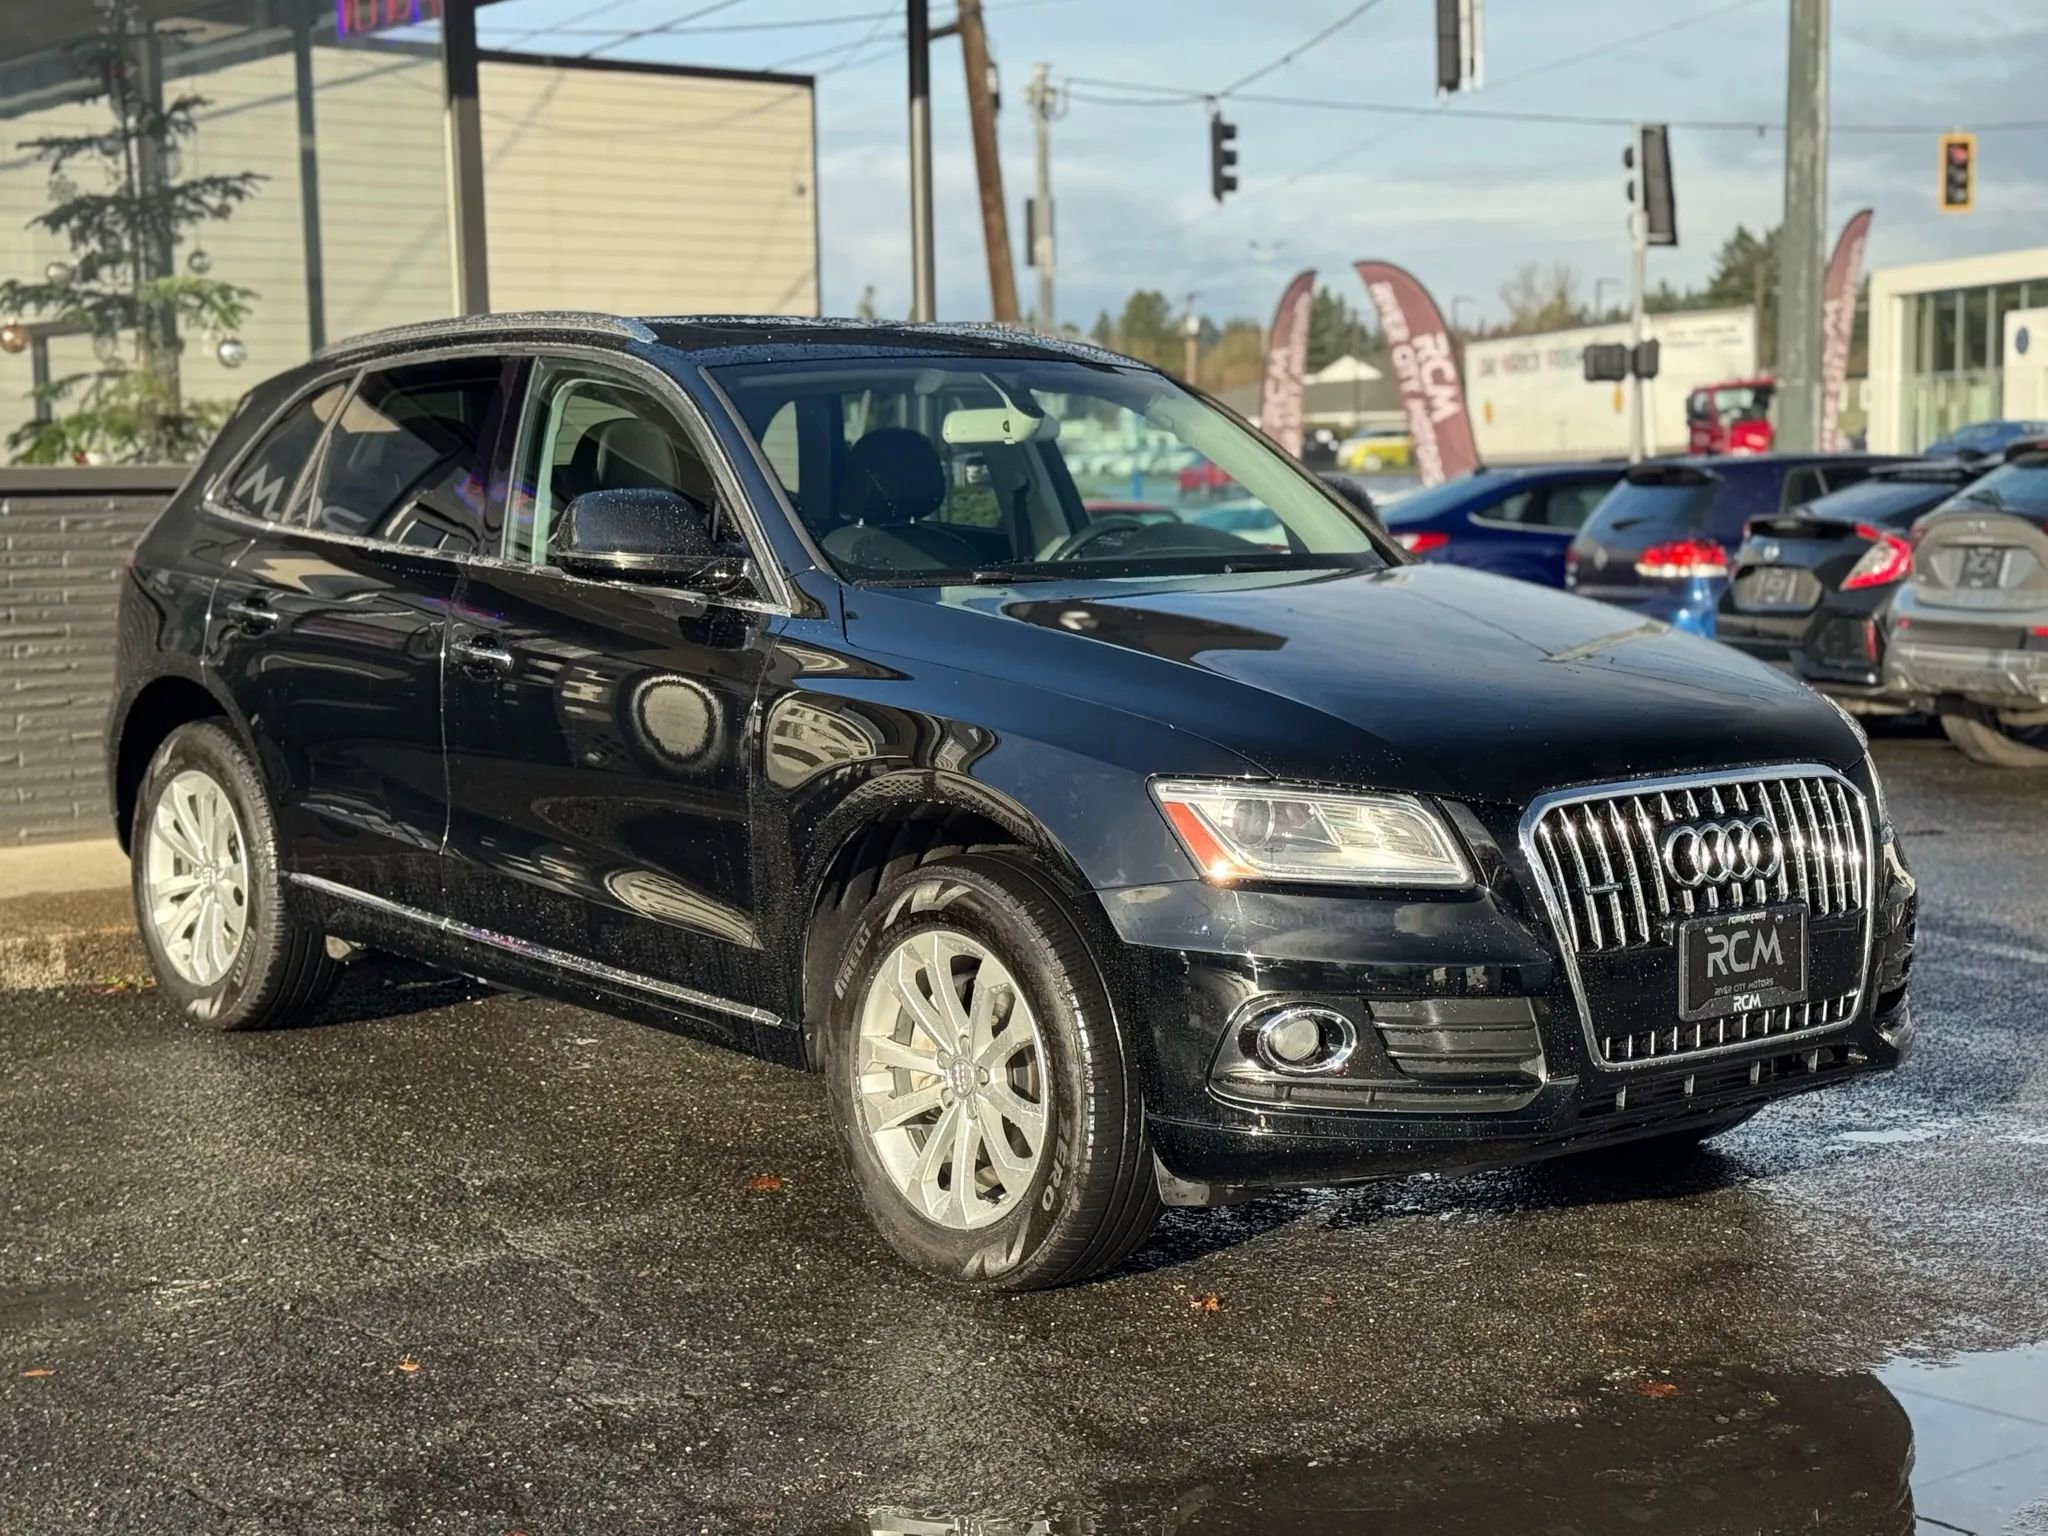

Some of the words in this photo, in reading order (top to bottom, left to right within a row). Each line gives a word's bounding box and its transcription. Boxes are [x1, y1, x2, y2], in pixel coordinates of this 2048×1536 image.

[1391, 343, 1424, 394] CITY
[1411, 330, 1464, 425] RCM
[833, 920, 872, 1001] PIRELLI
[1706, 925, 1784, 979] RCM
[1714, 984, 1733, 996] RIVER
[1733, 982, 1747, 992] CITY
[1747, 977, 1774, 990] MOTORS
[1733, 992, 1762, 1012] RCM
[1041, 1111, 1072, 1212] ZERO
